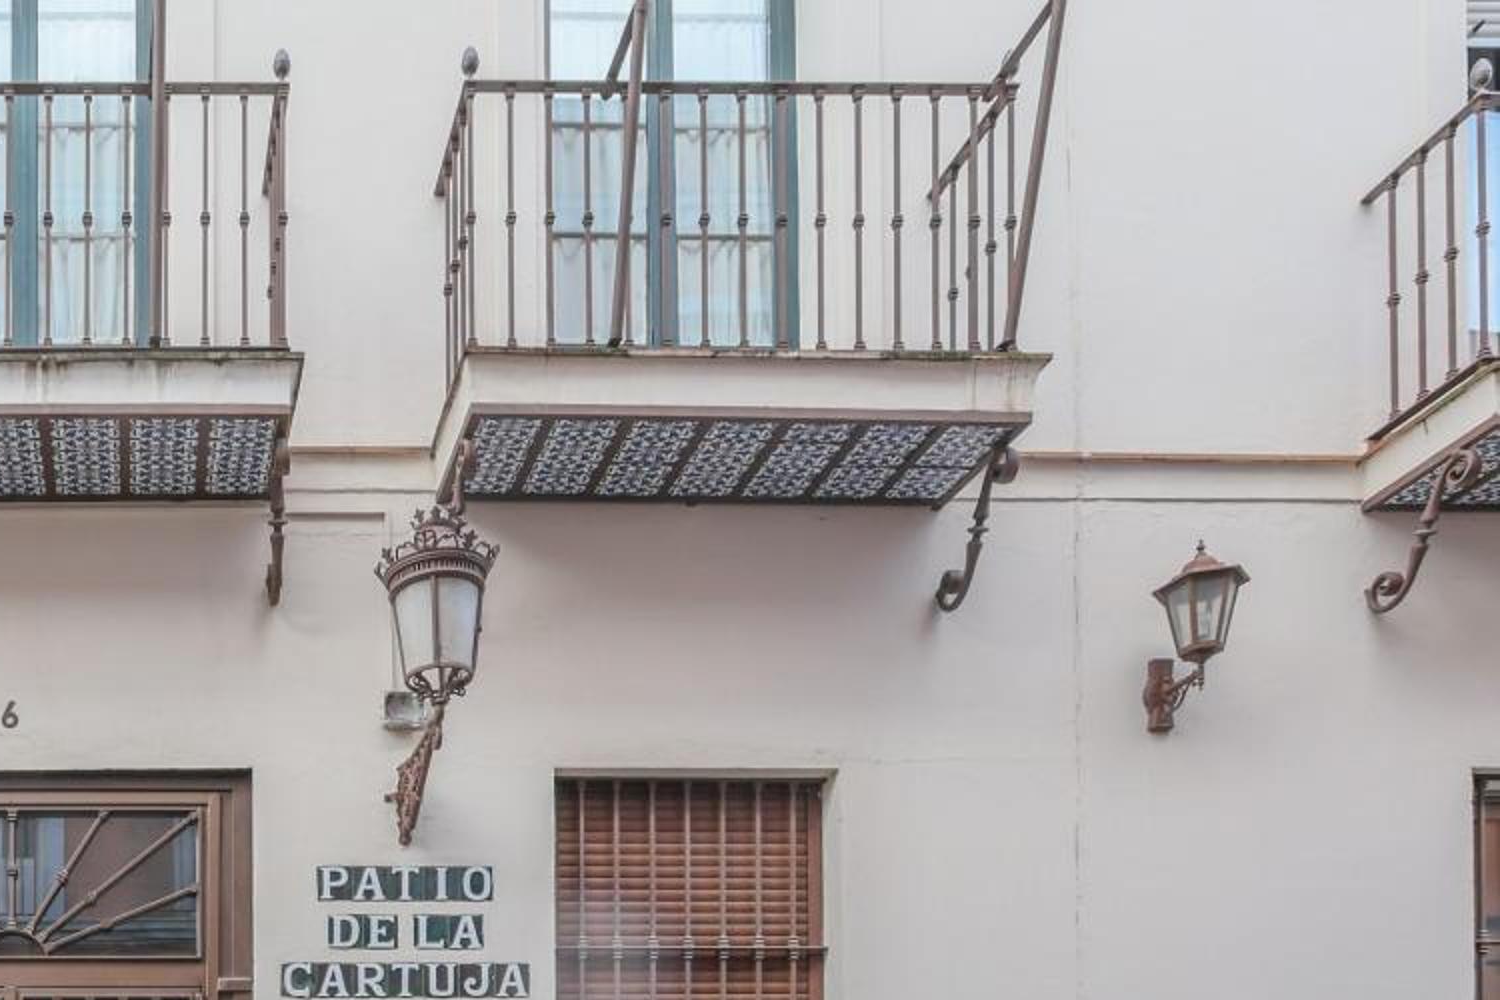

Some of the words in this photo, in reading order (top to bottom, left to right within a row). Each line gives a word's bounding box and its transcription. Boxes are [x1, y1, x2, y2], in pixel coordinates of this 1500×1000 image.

[1, 699, 19, 729] 6
[319, 866, 492, 900] PATIO
[330, 915, 396, 948] DE
[416, 915, 483, 948] LA
[282, 963, 530, 997] CARTUJA
